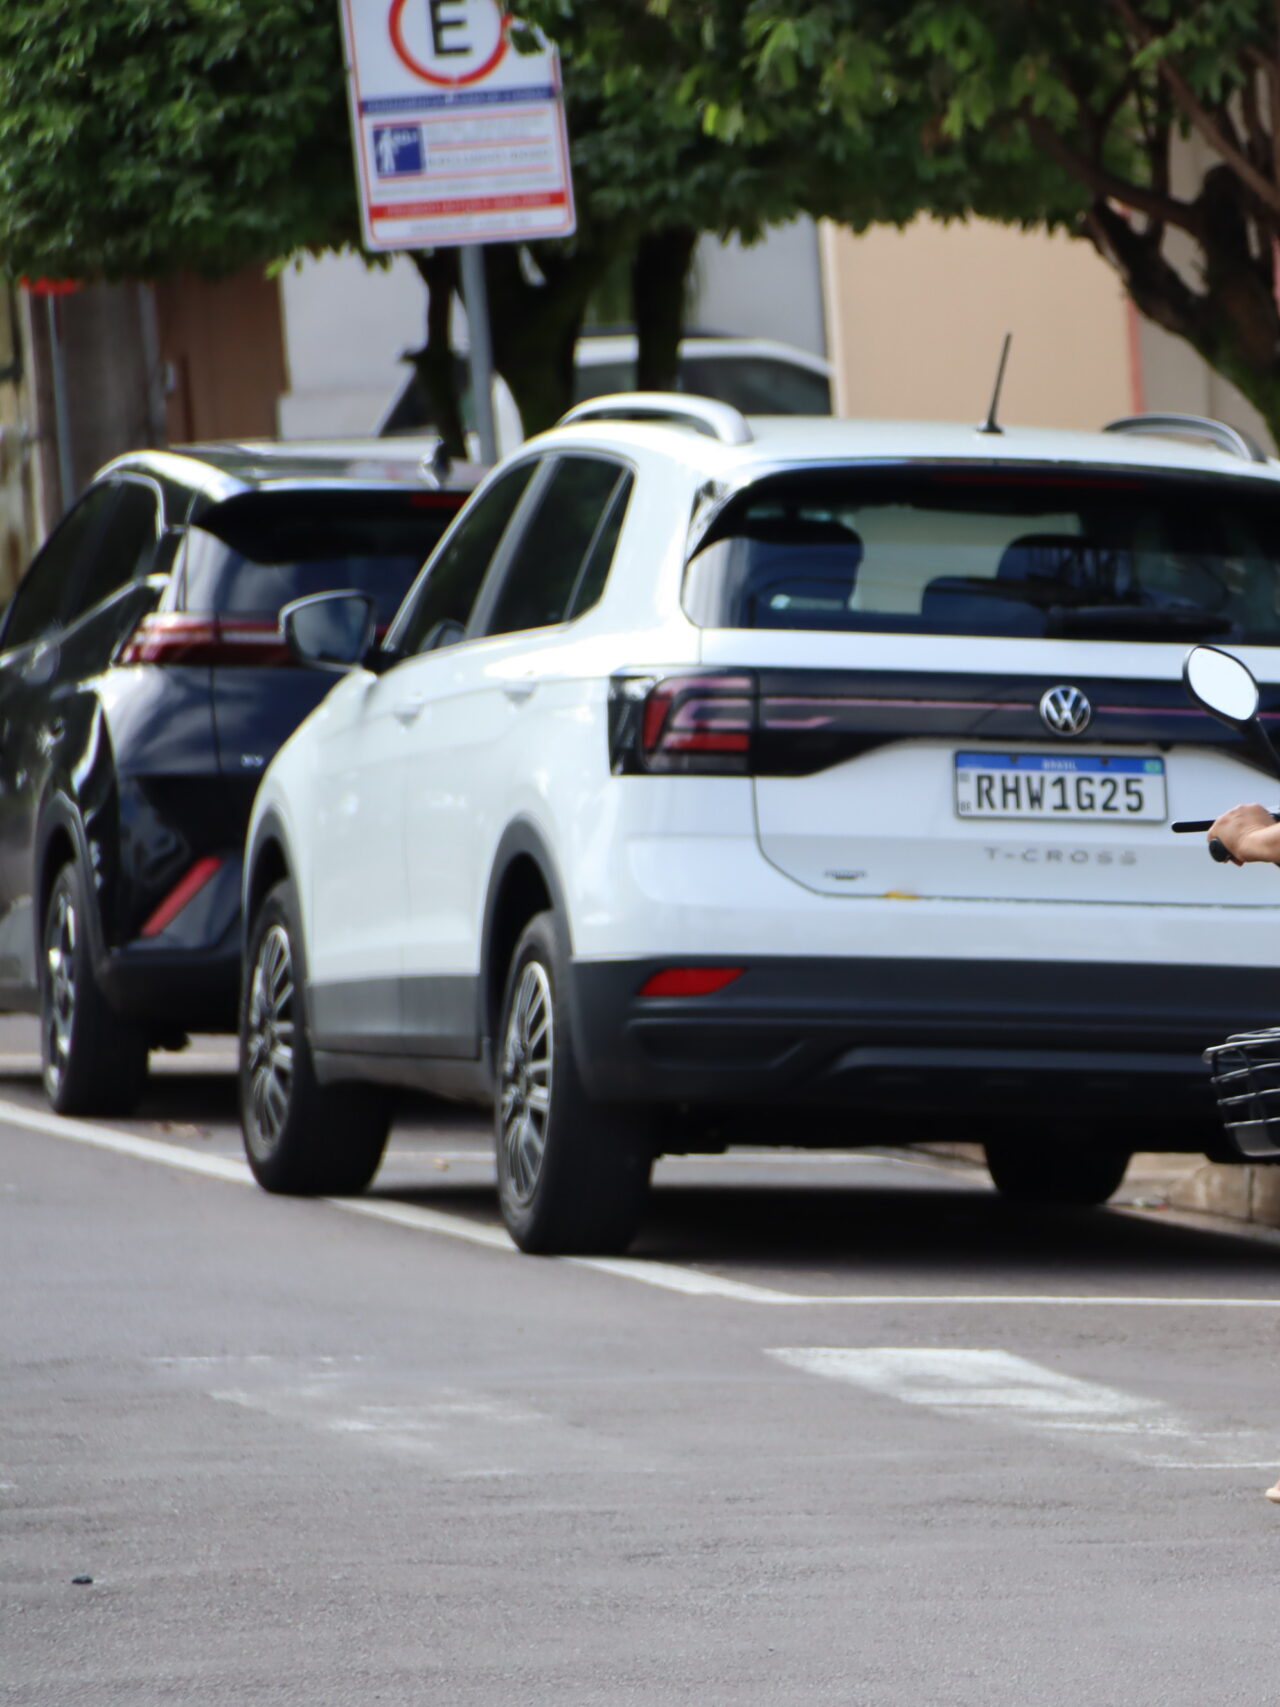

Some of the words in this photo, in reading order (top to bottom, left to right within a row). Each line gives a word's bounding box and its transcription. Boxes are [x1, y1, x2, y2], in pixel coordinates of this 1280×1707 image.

[428, 0, 473, 57] E
[1042, 759, 1078, 771] BRASIL
[976, 774, 1144, 812] RHW1G25
[983, 846, 1138, 866] T-CROSS
